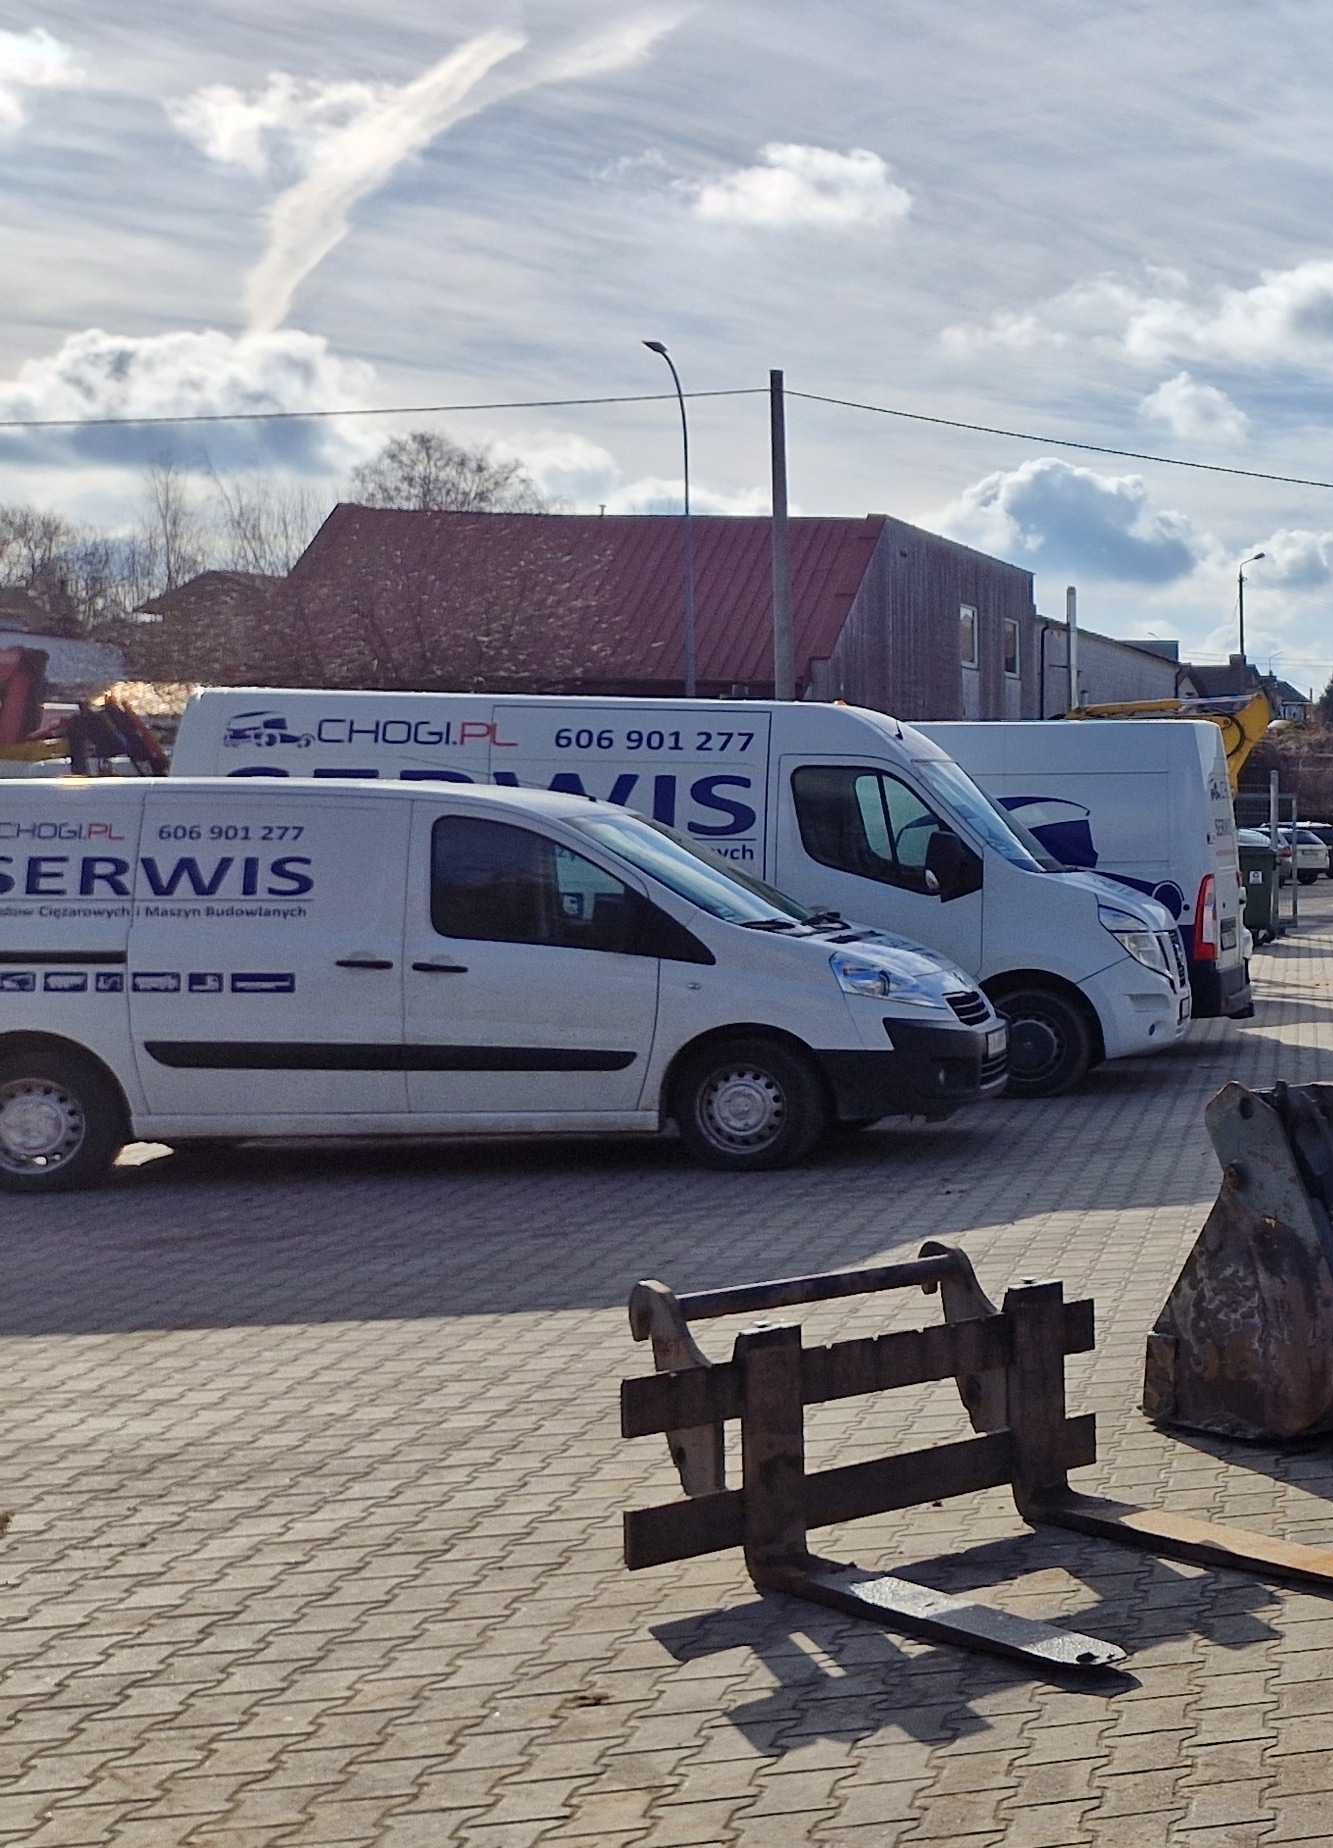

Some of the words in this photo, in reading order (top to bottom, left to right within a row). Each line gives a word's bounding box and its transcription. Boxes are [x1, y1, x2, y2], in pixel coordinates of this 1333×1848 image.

[317, 719, 518, 746] CHOGI.PL
[555, 728, 614, 749] 606
[626, 730, 684, 750] 901
[696, 732, 755, 751] 277
[158, 824, 201, 840] 606
[209, 825, 252, 840] 901
[261, 825, 304, 841] 277
[145, 906, 200, 919] Maszyn
[205, 906, 307, 920] Budowlanych
